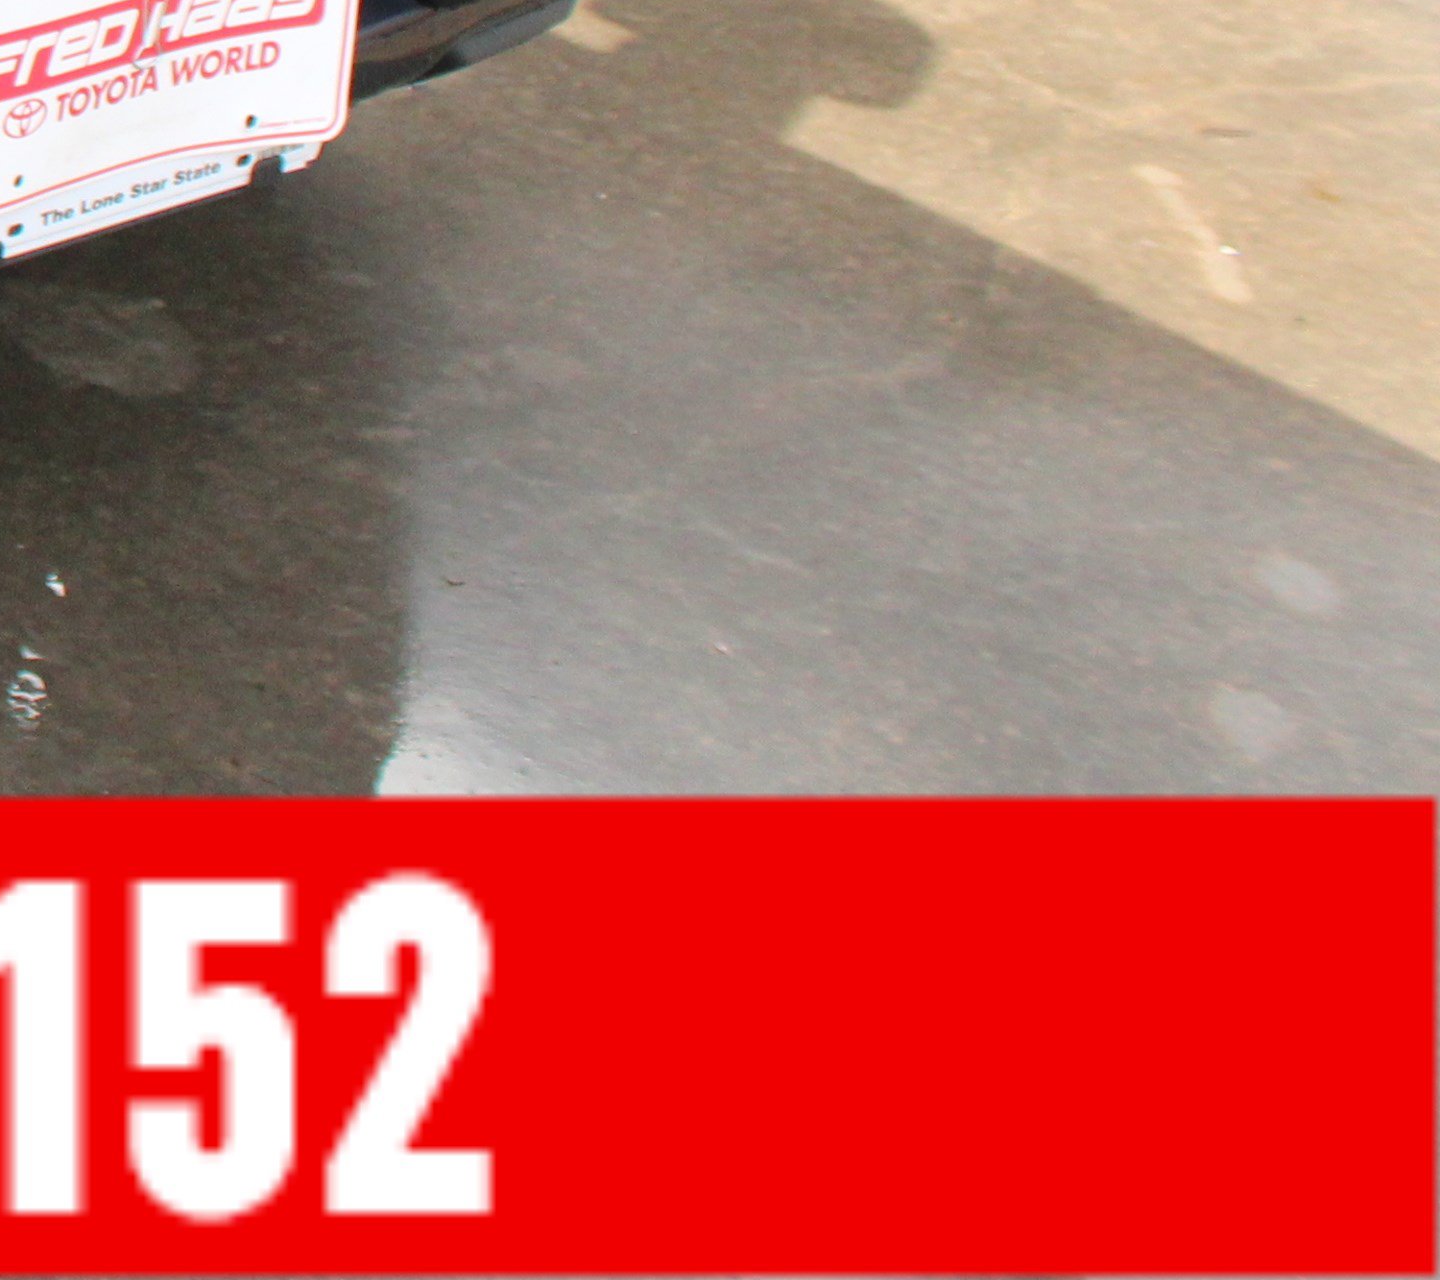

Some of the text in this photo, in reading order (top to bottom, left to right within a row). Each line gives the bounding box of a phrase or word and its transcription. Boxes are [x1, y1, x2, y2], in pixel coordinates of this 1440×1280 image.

[56, 40, 281, 123] TOYOTA WORLD
[40, 161, 222, 226] The Lone Star State
